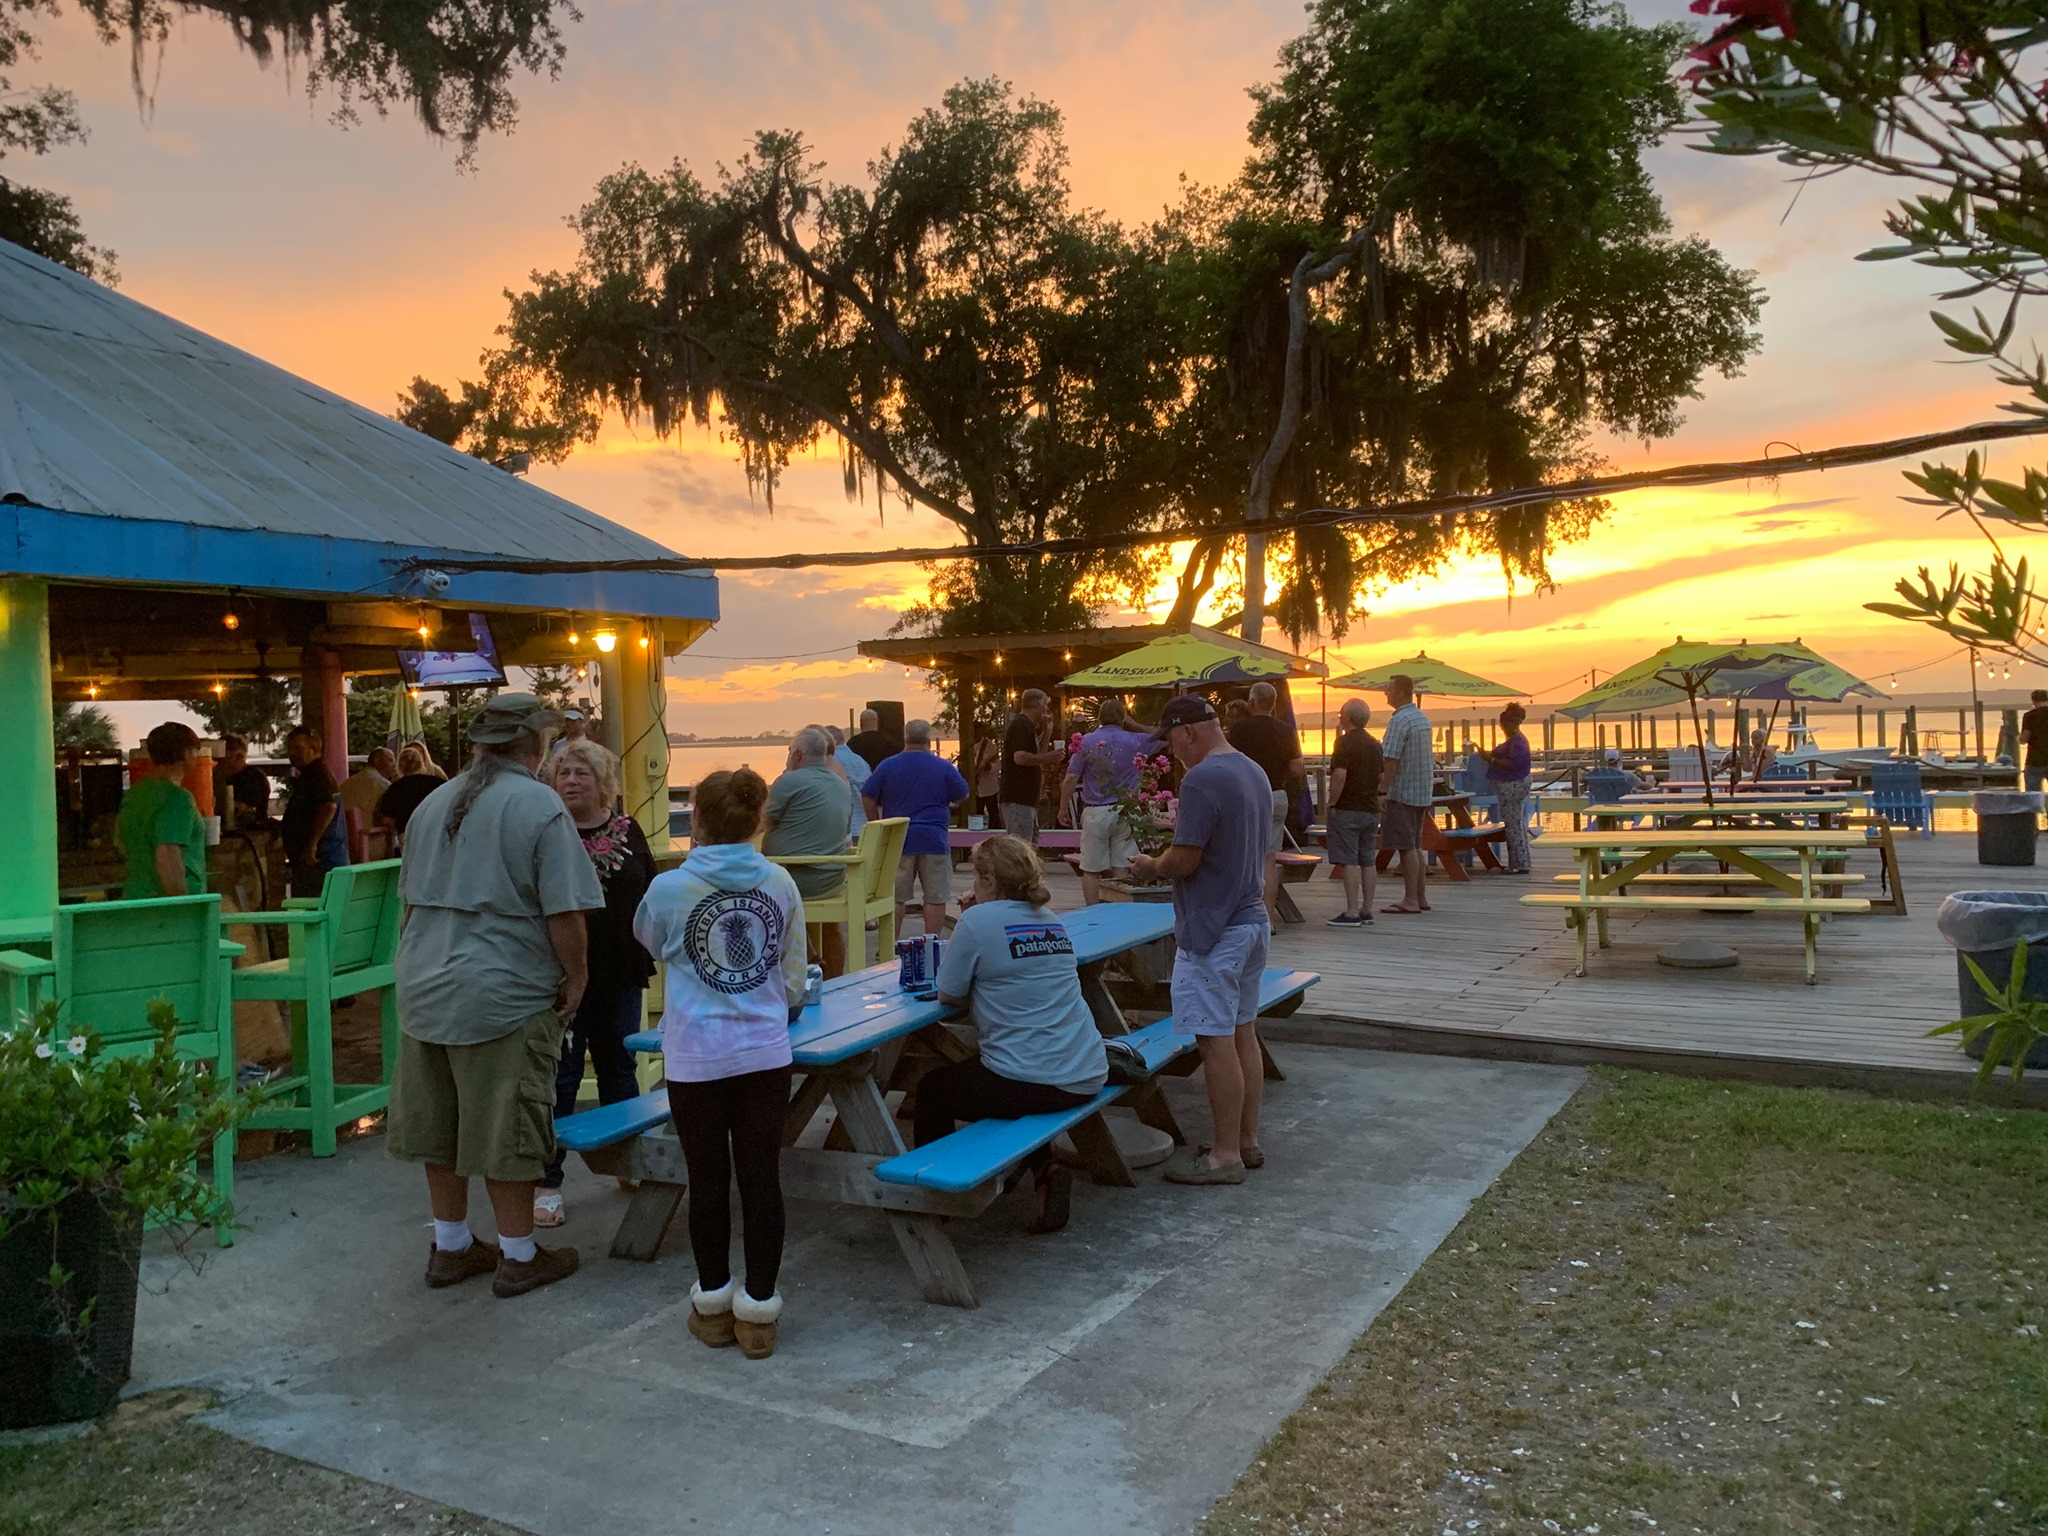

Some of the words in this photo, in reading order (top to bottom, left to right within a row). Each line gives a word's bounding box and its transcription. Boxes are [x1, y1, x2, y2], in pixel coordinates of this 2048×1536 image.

[1092, 665, 1173, 676] LANDSHARK
[697, 903, 725, 943] TYBEE
[733, 899, 775, 928] ISLAND
[702, 944, 777, 982] GEORGIA
